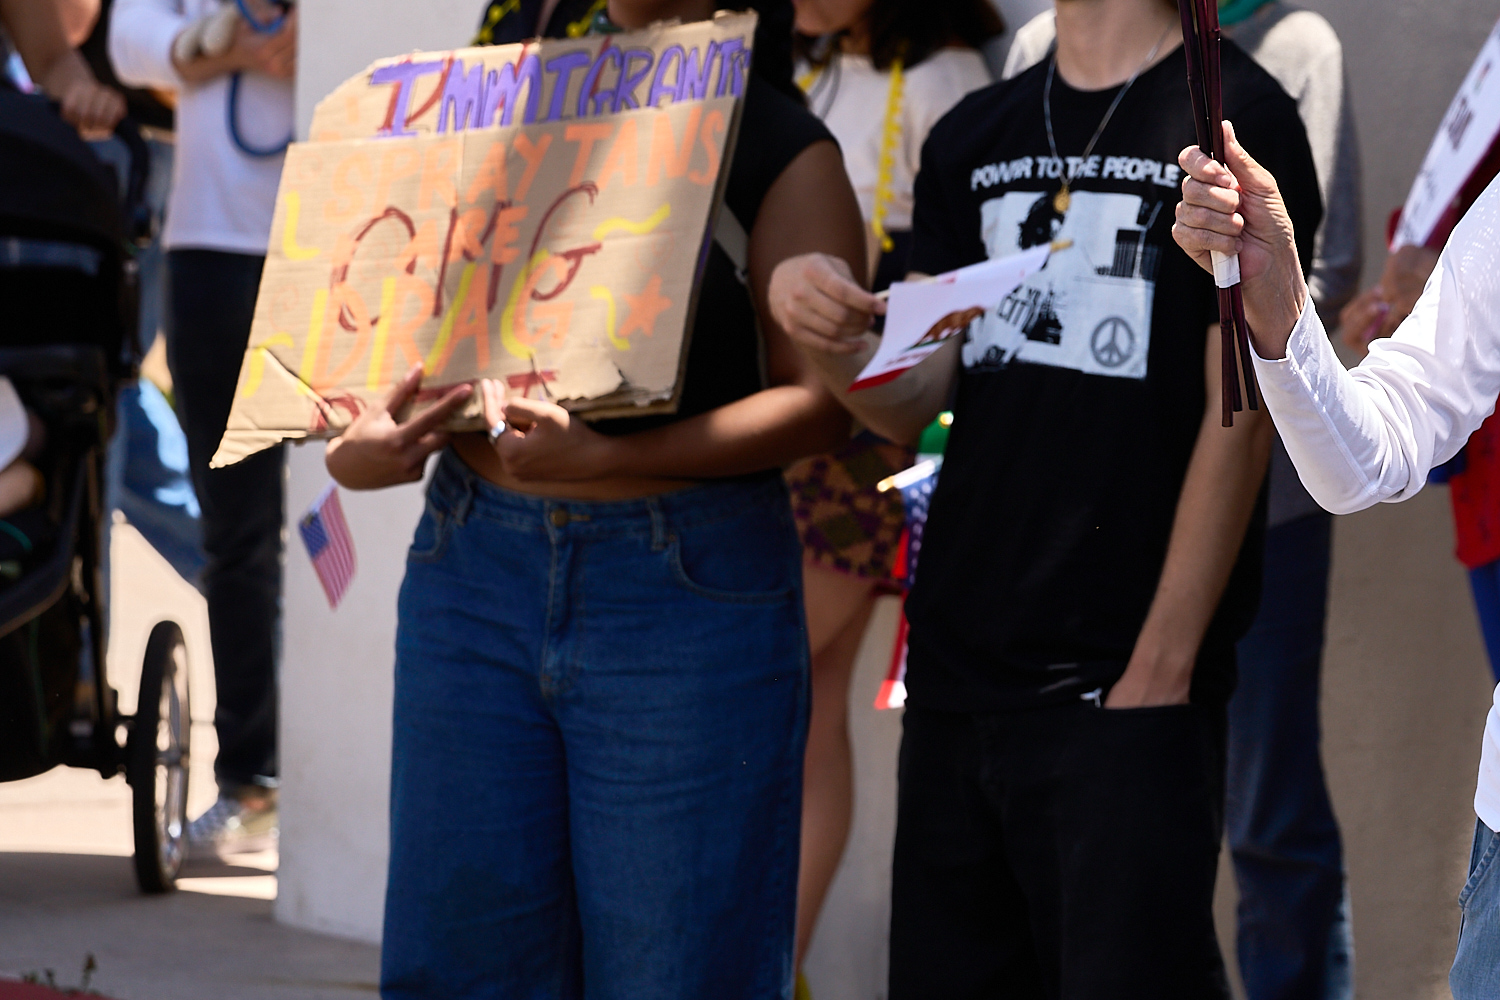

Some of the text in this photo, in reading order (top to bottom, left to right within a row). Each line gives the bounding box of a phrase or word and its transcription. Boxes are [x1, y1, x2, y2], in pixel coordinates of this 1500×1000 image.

[322, 106, 726, 220] SPRAY TANS
[1035, 155, 1064, 180] TO
[1102, 154, 1181, 188] PEOPLE
[394, 206, 530, 271] ARE
[297, 250, 576, 394] DRAG
